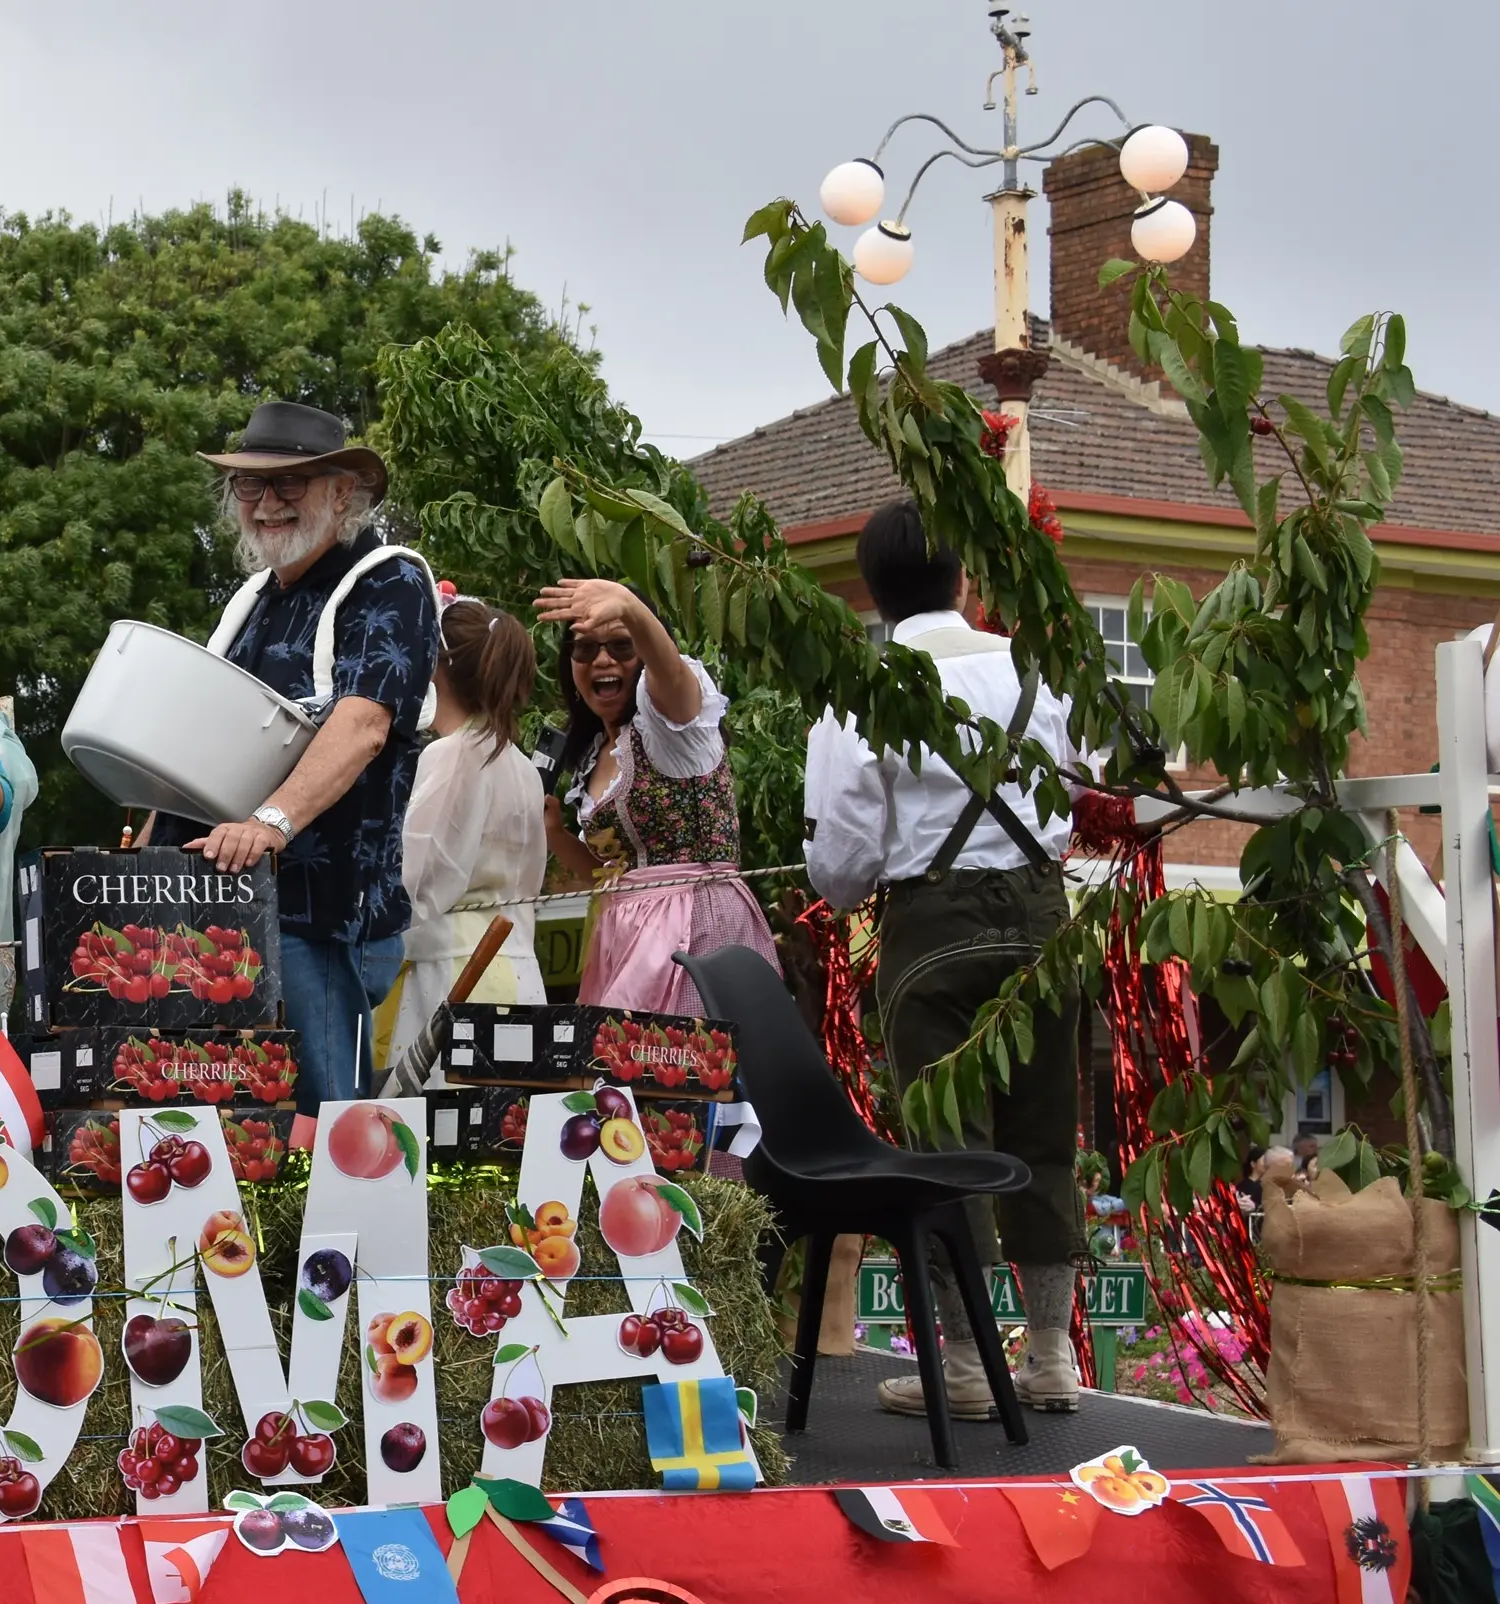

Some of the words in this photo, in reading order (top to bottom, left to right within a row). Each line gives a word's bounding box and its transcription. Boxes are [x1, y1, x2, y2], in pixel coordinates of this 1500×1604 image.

[72, 874, 255, 905] CHERRIES
[630, 1043, 699, 1067] CHERRIES
[161, 1062, 247, 1081] CHERRIES
